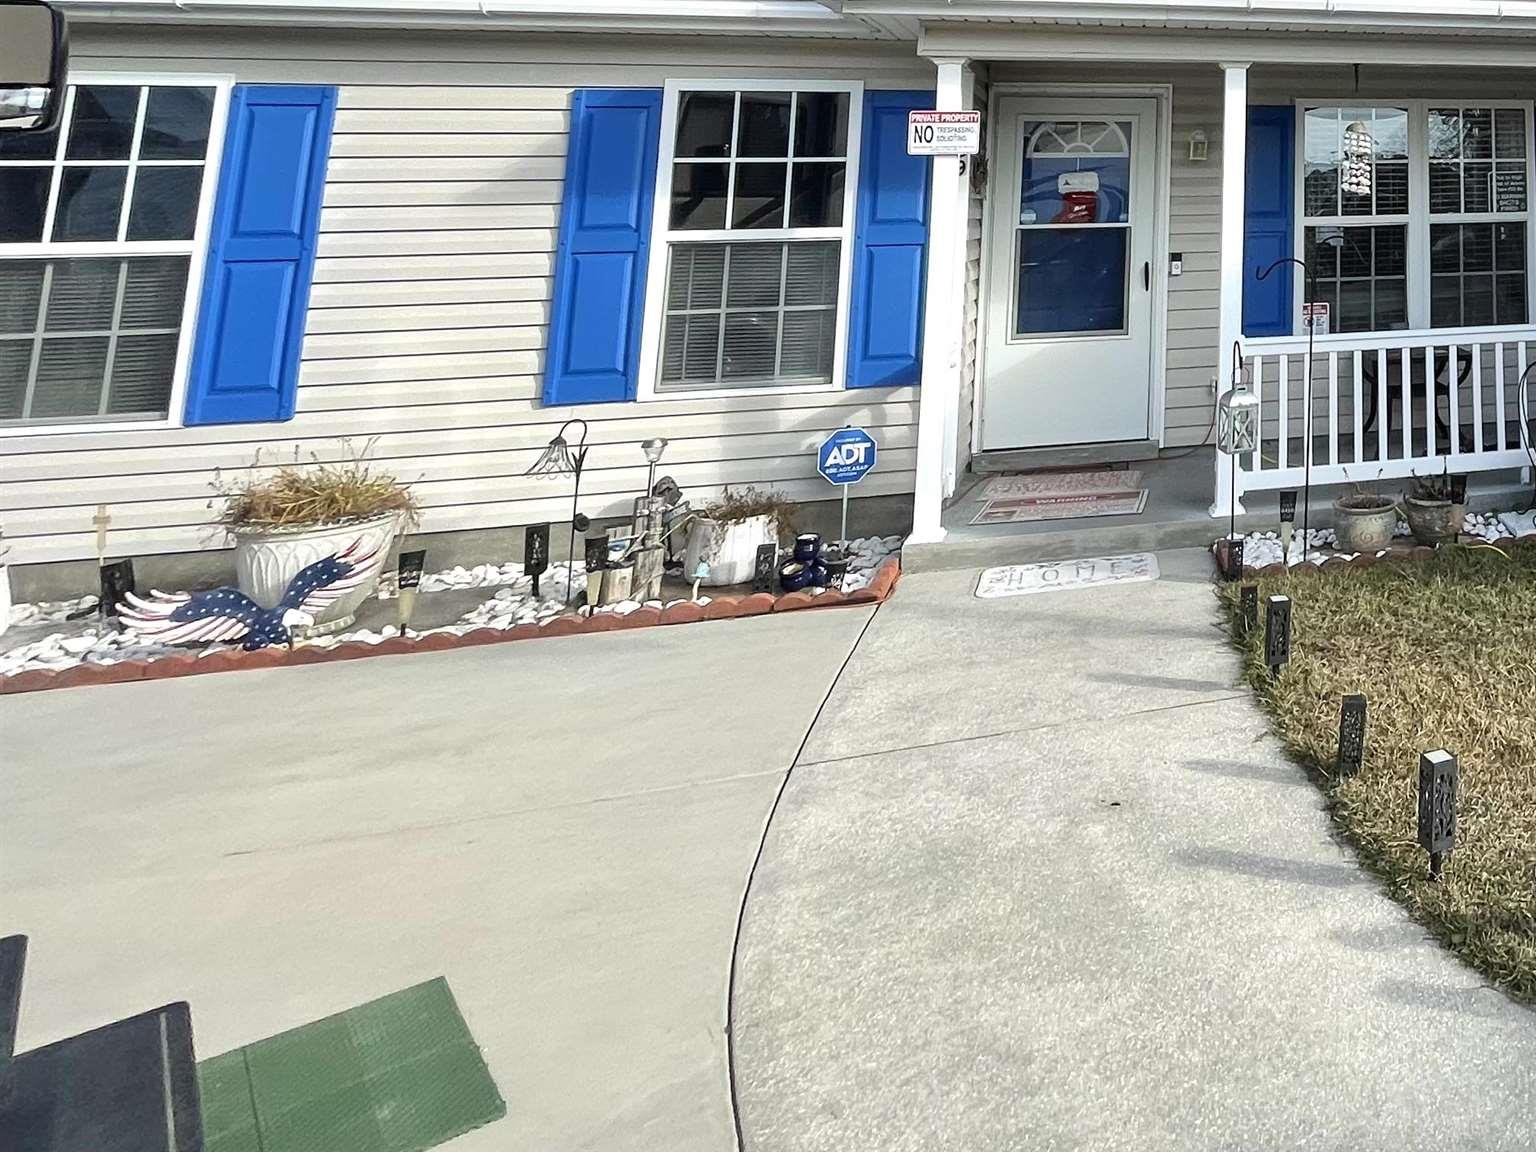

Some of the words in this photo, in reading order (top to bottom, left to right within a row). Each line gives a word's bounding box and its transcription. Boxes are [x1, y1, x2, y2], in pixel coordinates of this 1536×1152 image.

[911, 113, 941, 123] PRIVATE
[941, 113, 979, 123] PROPERTY
[914, 125, 934, 144] NO
[824, 442, 871, 467] ADT
[1008, 561, 1122, 586] HOME
